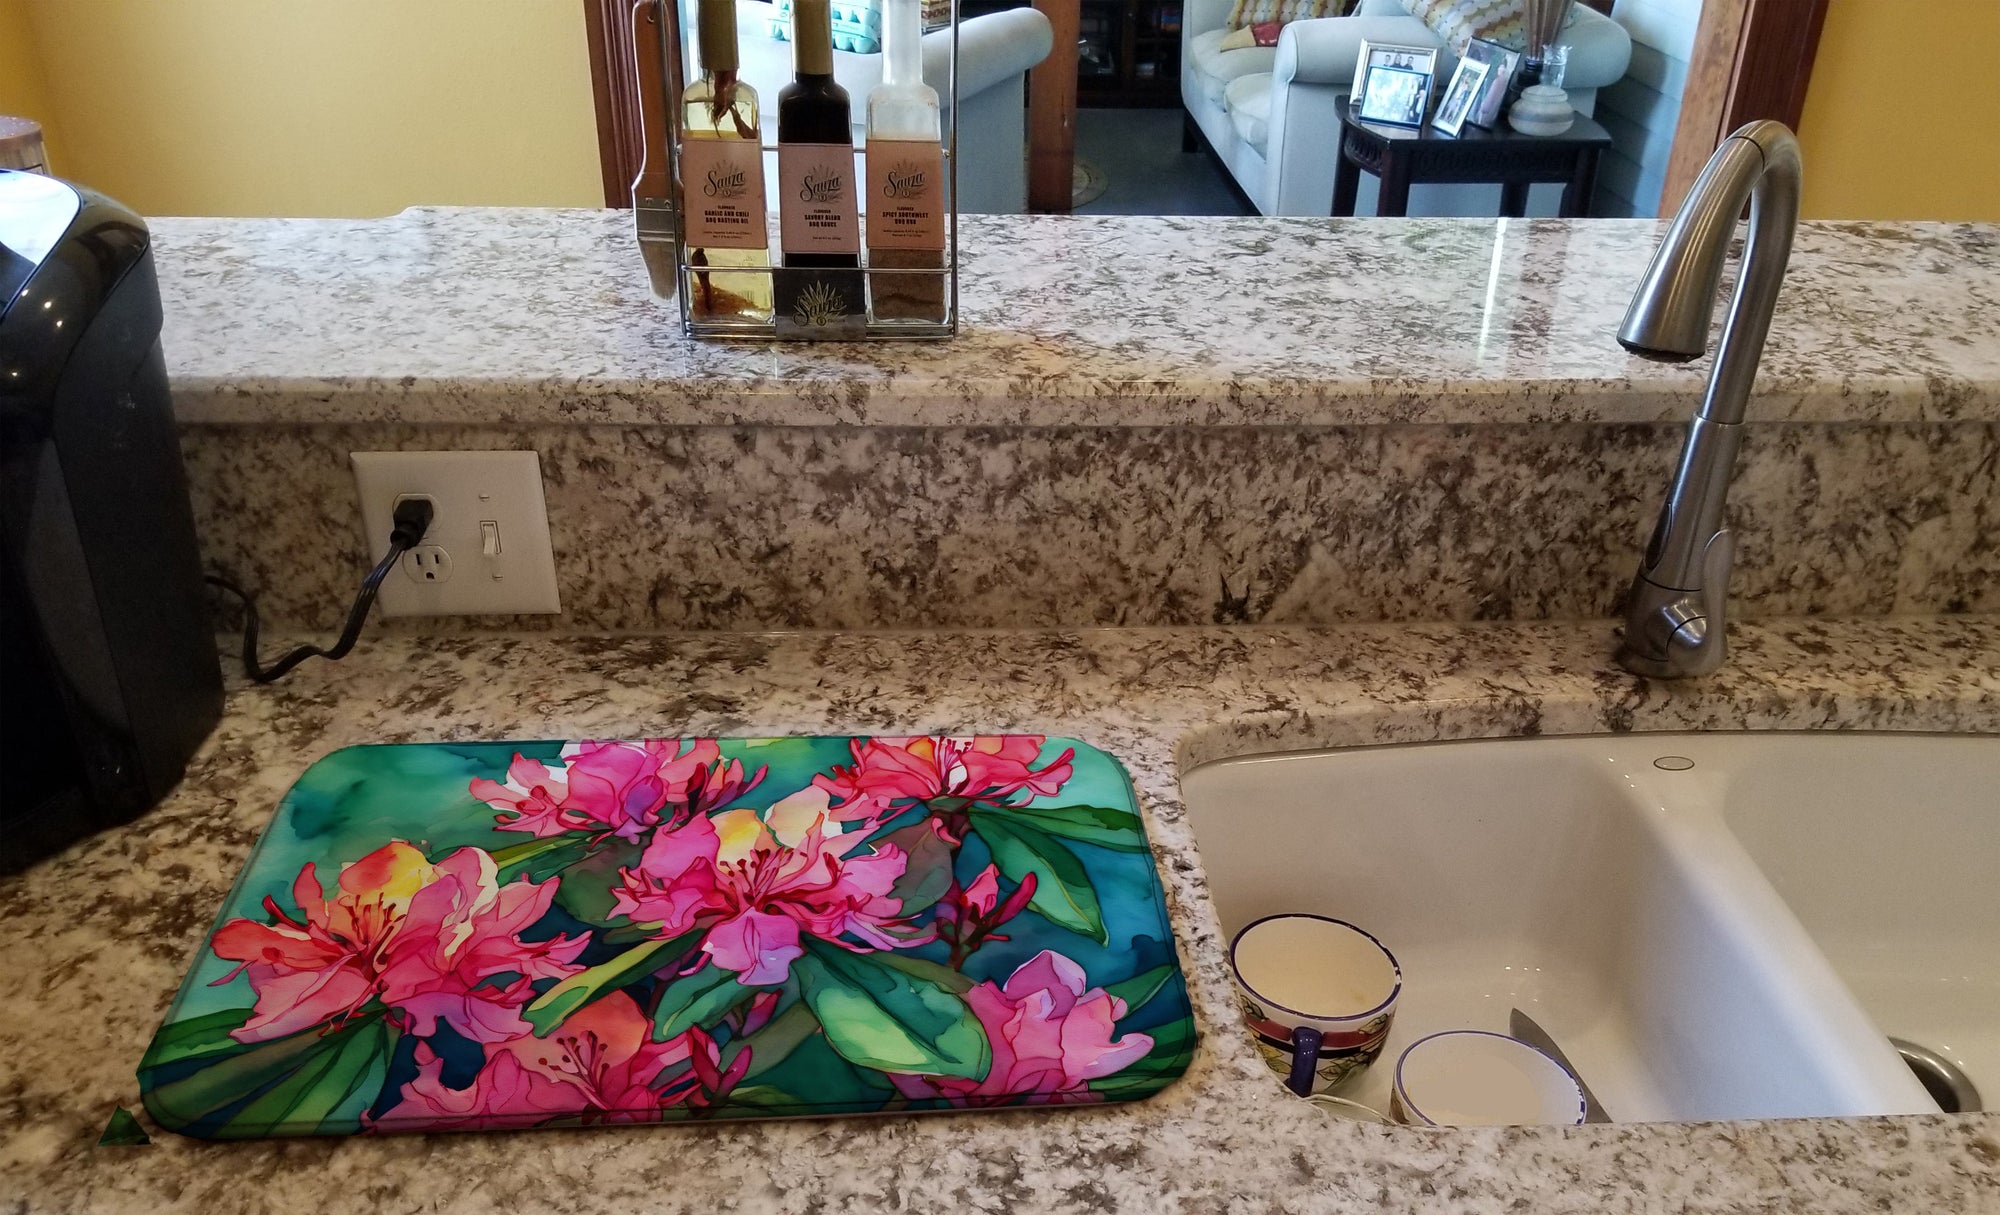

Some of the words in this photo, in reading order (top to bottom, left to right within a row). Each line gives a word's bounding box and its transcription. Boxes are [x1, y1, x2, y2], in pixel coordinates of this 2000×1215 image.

[703, 170, 745, 197] Sauza
[800, 175, 841, 202] Sauza
[883, 171, 924, 198] Sauza
